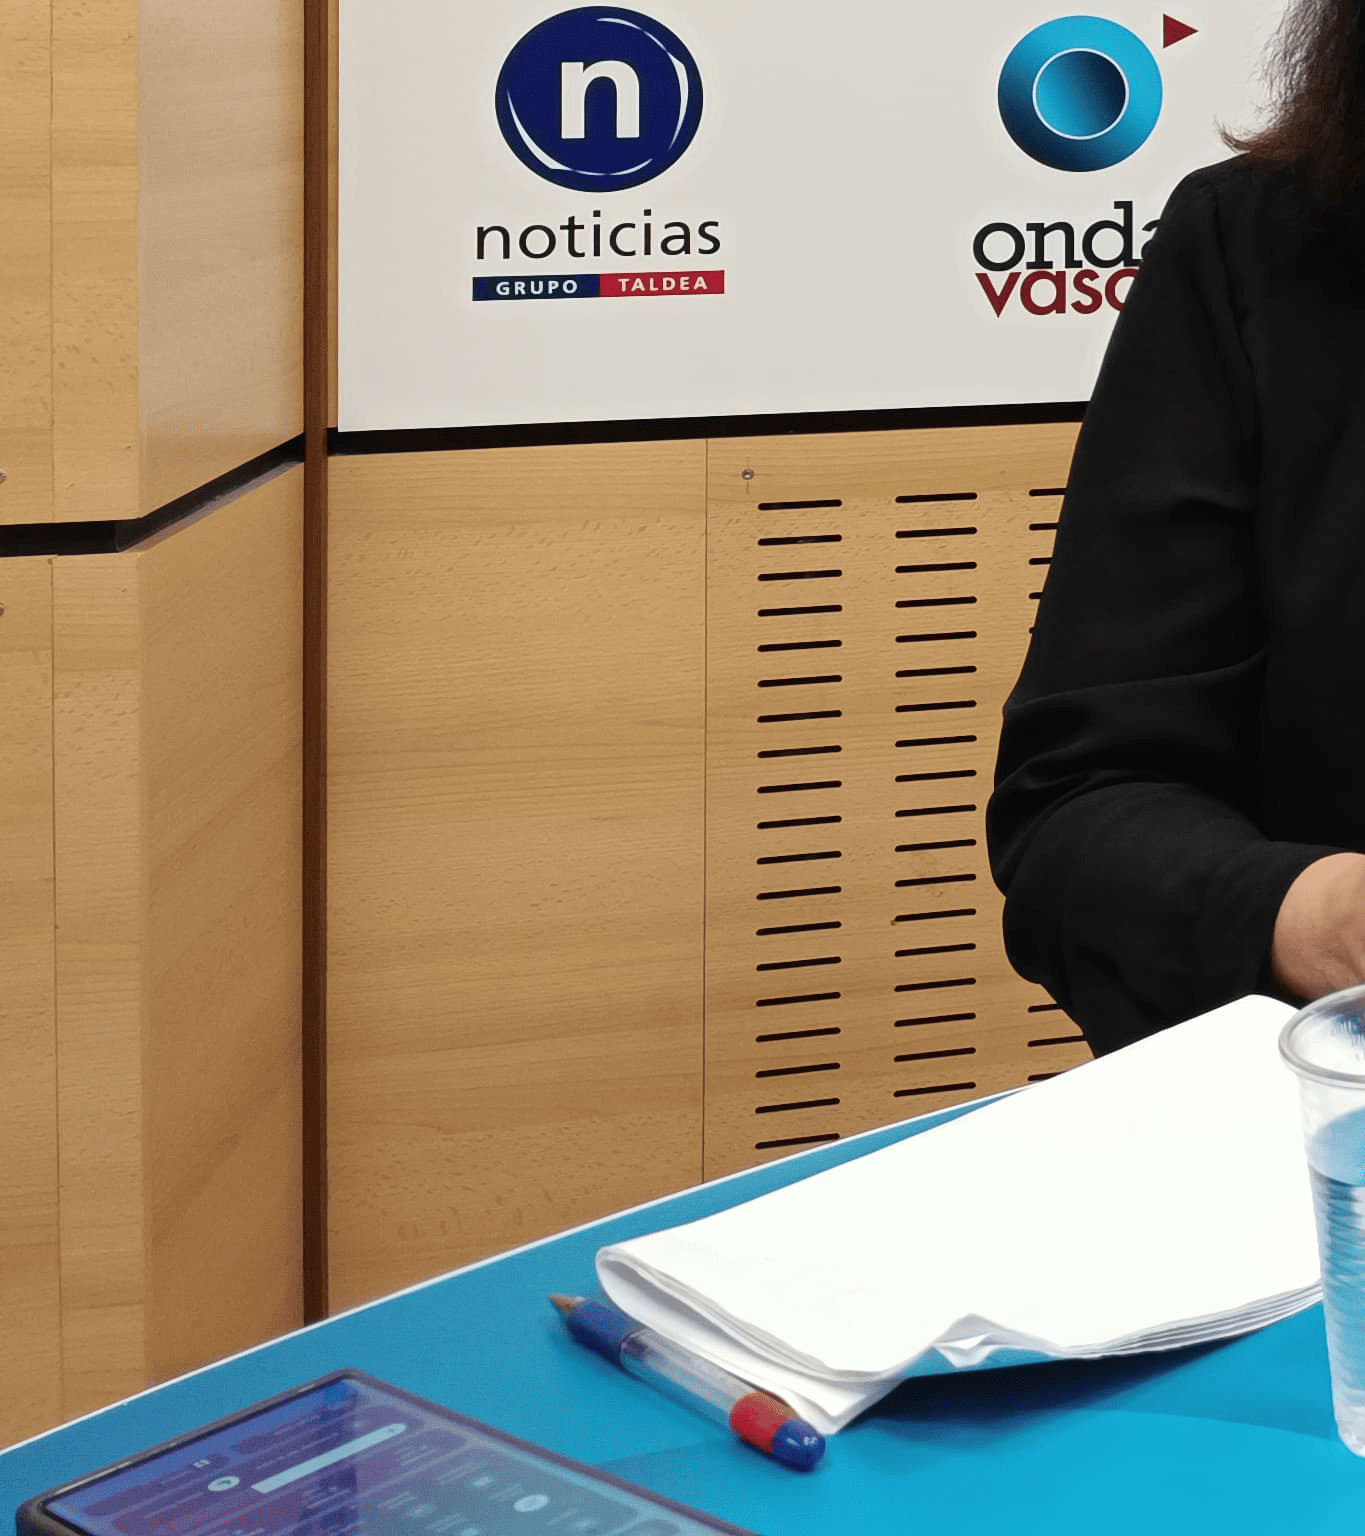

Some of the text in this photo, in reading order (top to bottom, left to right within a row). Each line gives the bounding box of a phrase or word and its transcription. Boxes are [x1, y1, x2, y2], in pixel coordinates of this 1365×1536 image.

[560, 59, 640, 140] n
[476, 208, 721, 260] noticias
[495, 275, 709, 296] GRUPO TALDEA
[975, 267, 1140, 319] vasc
